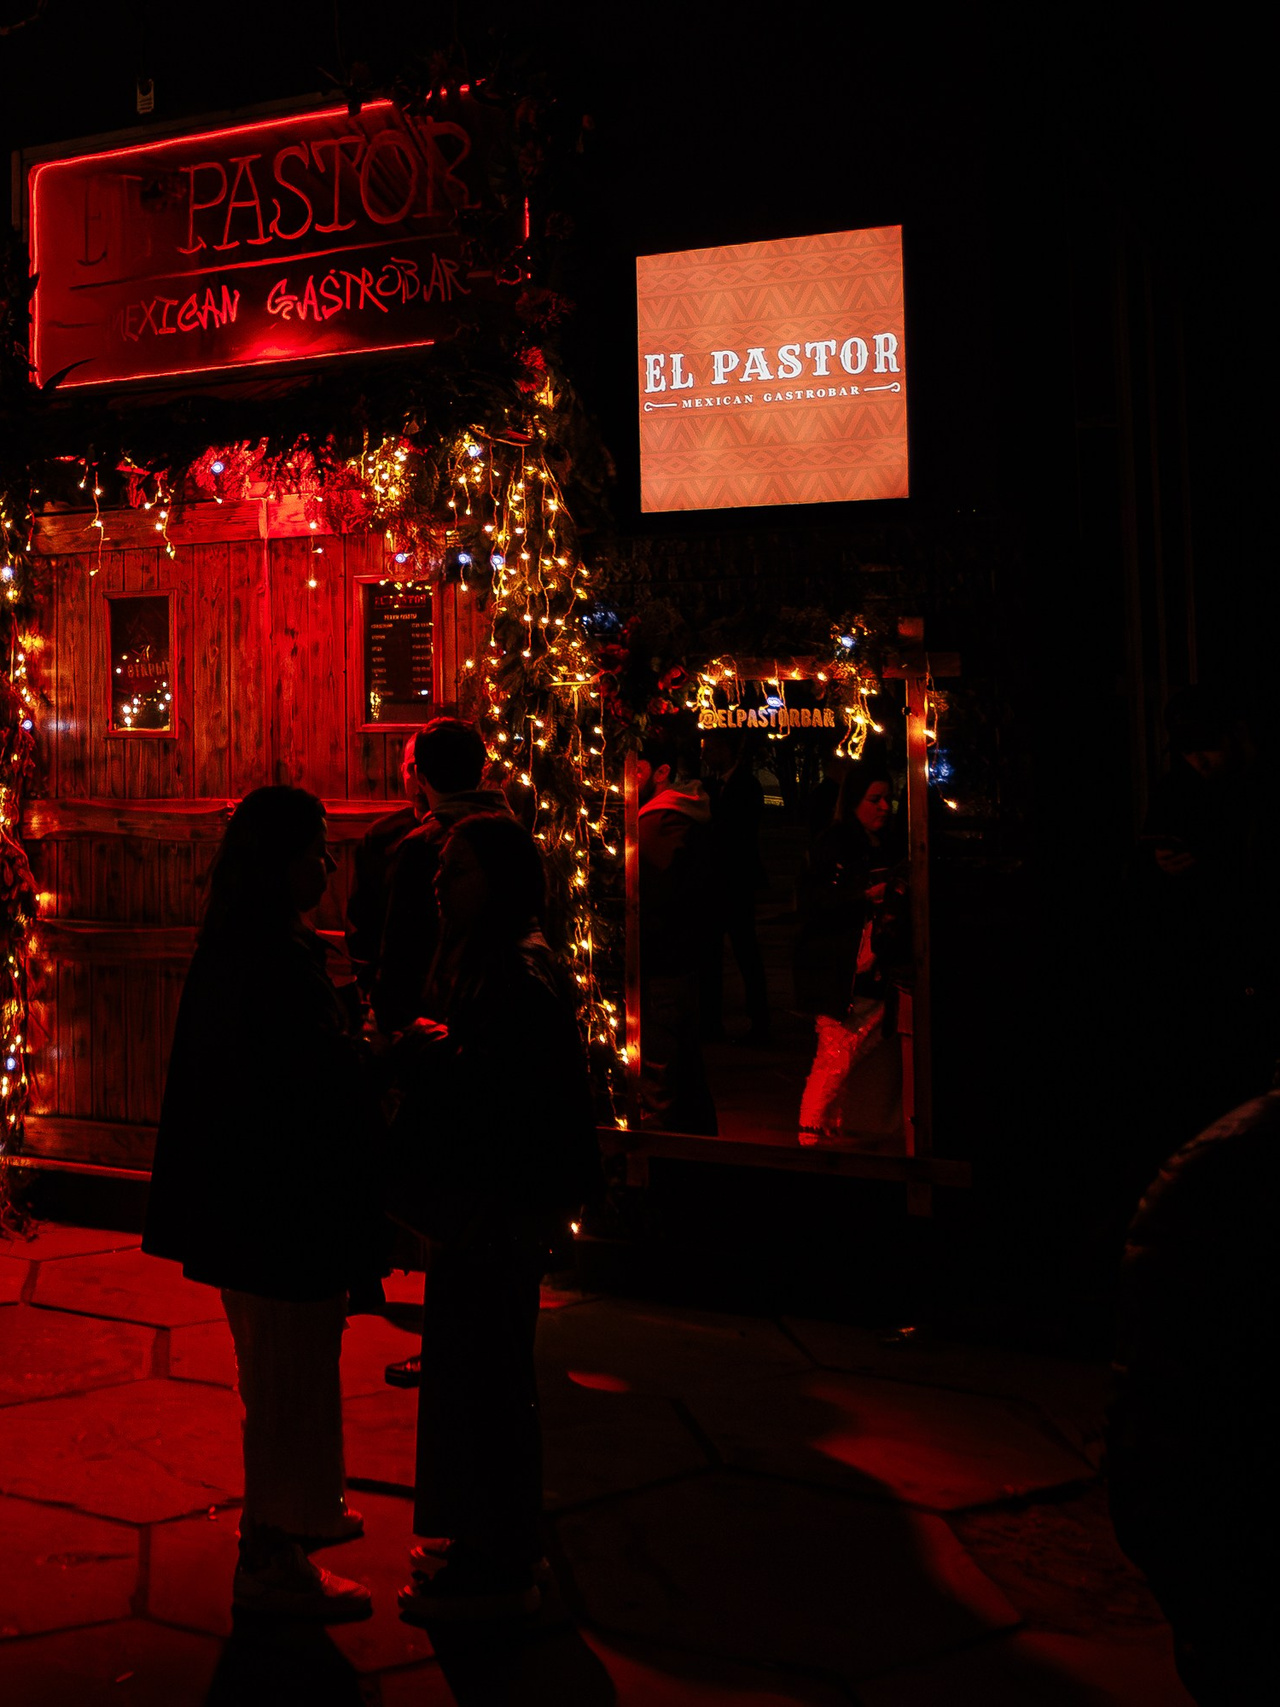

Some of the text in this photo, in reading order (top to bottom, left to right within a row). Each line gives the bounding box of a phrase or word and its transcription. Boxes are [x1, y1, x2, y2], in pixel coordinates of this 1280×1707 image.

[177, 115, 482, 254] PASTOR
[266, 252, 472, 322] GASTROBAR
[644, 332, 901, 393] EL PASTOR
[682, 385, 861, 409] MEXICAN GASTROBAR
[699, 708, 836, 729] @ELPASTORBAR
